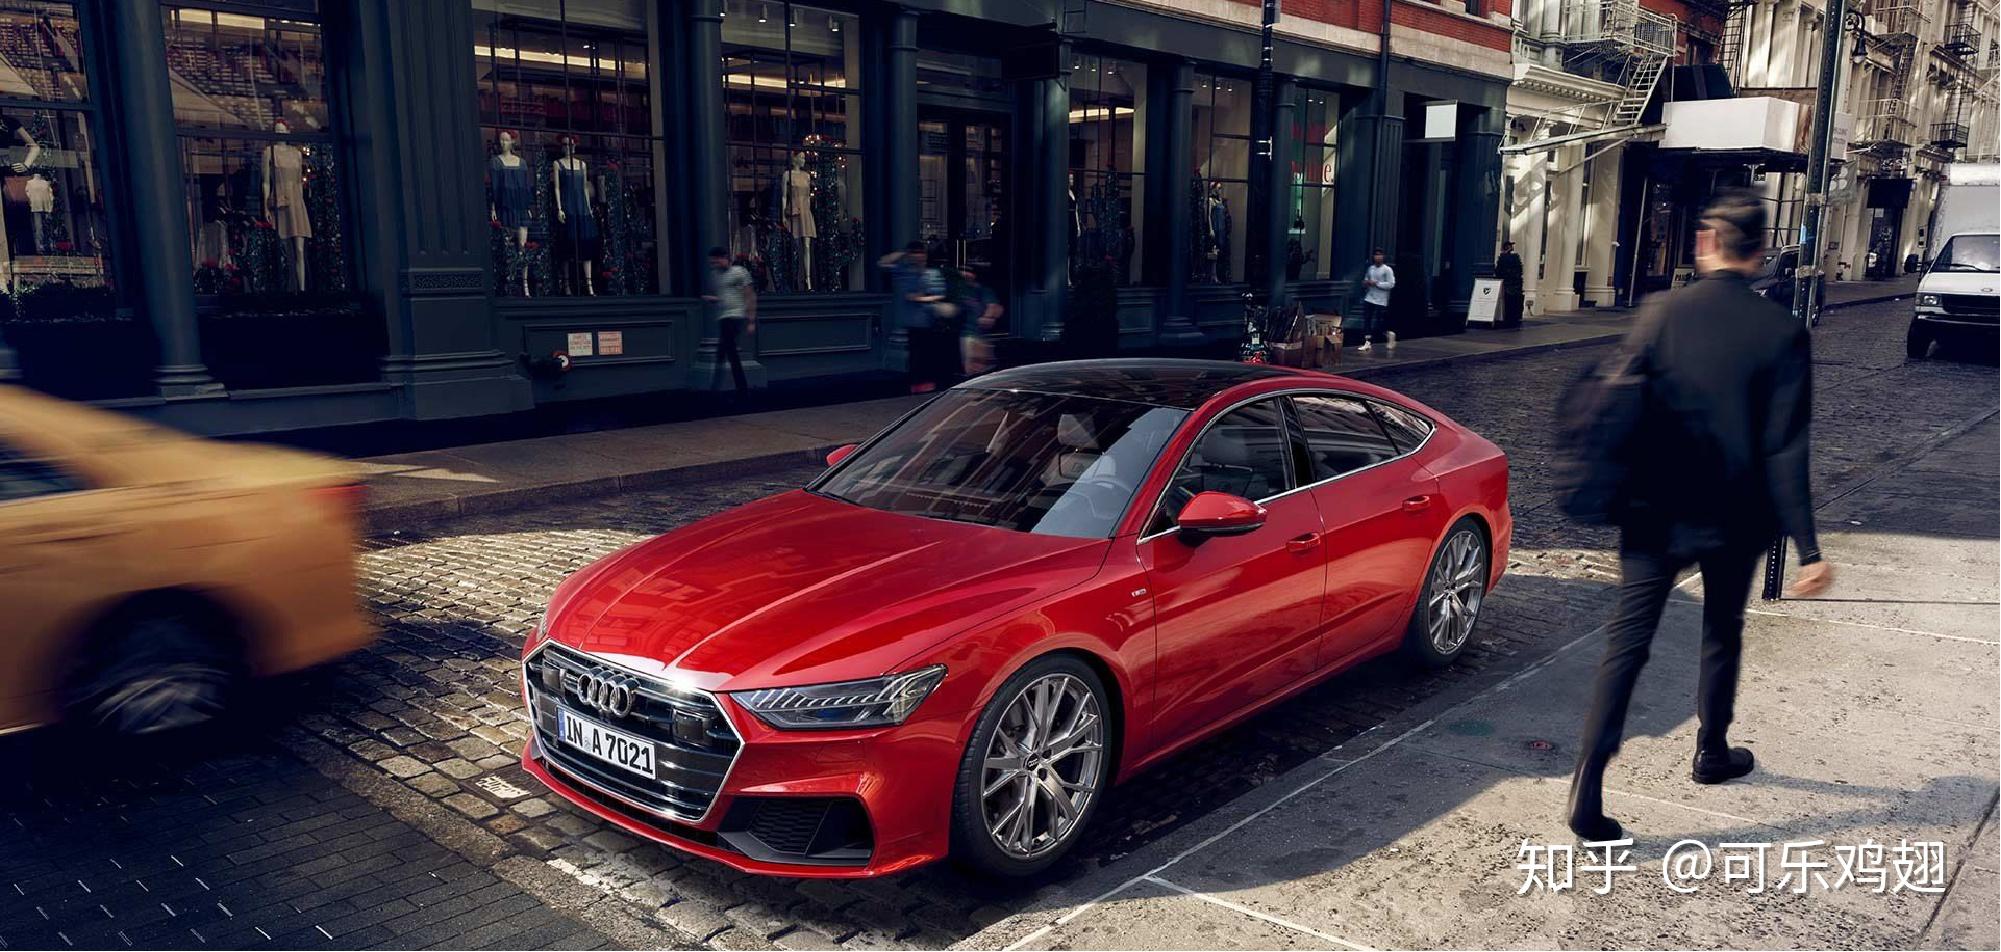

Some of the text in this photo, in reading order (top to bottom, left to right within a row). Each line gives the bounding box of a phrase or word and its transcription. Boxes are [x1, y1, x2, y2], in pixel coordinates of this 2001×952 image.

[566, 715, 653, 774] IN A 7021
